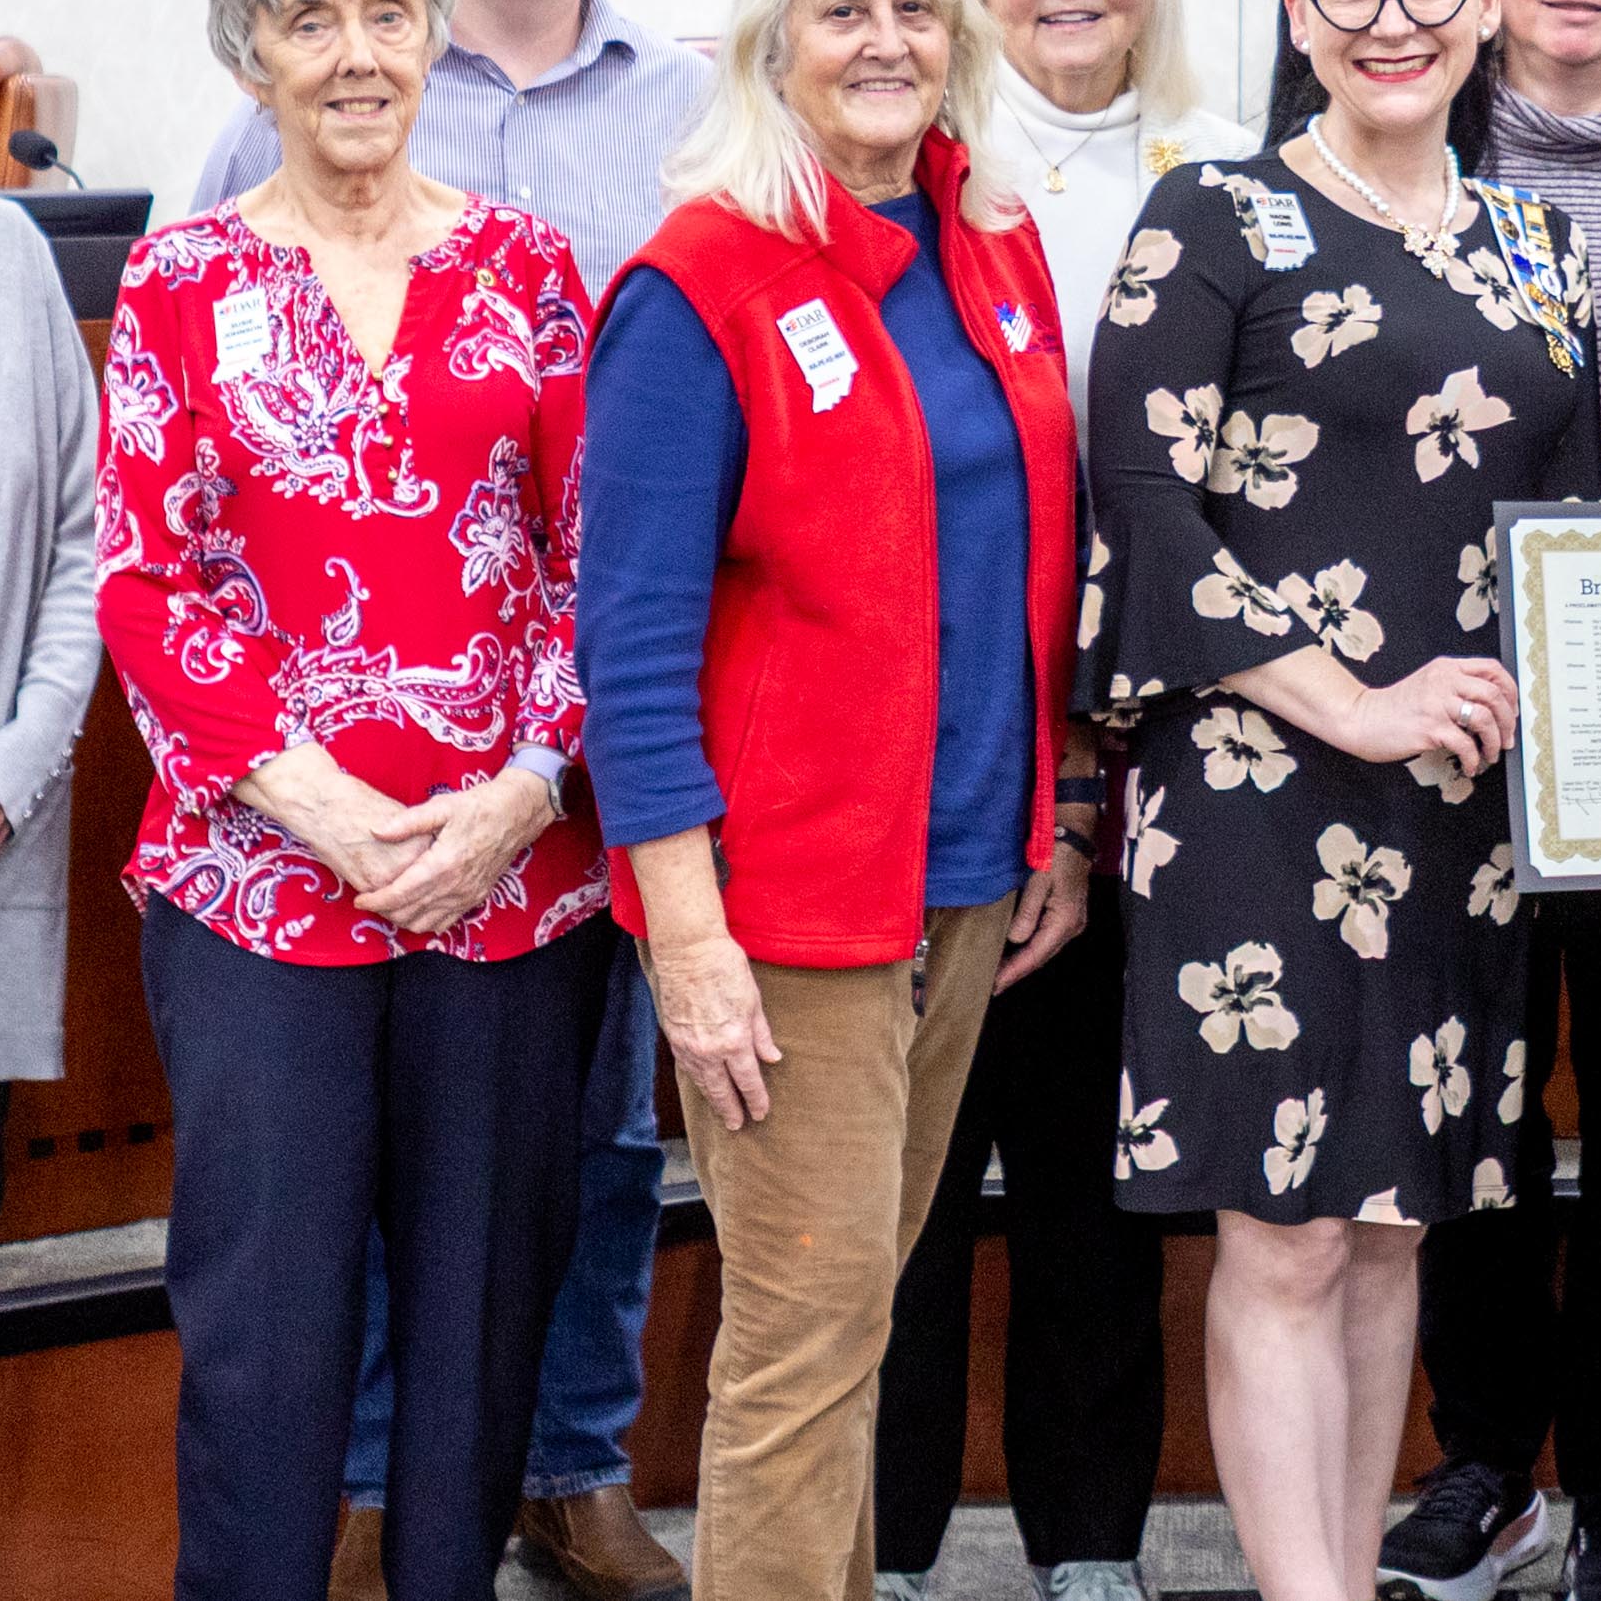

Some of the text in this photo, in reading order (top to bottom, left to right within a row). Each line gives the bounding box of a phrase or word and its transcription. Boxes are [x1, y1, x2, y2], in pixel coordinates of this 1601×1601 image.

[1267, 197, 1295, 208] DAR
[796, 308, 826, 328] DAR
[799, 331, 830, 348] DEBORAH
